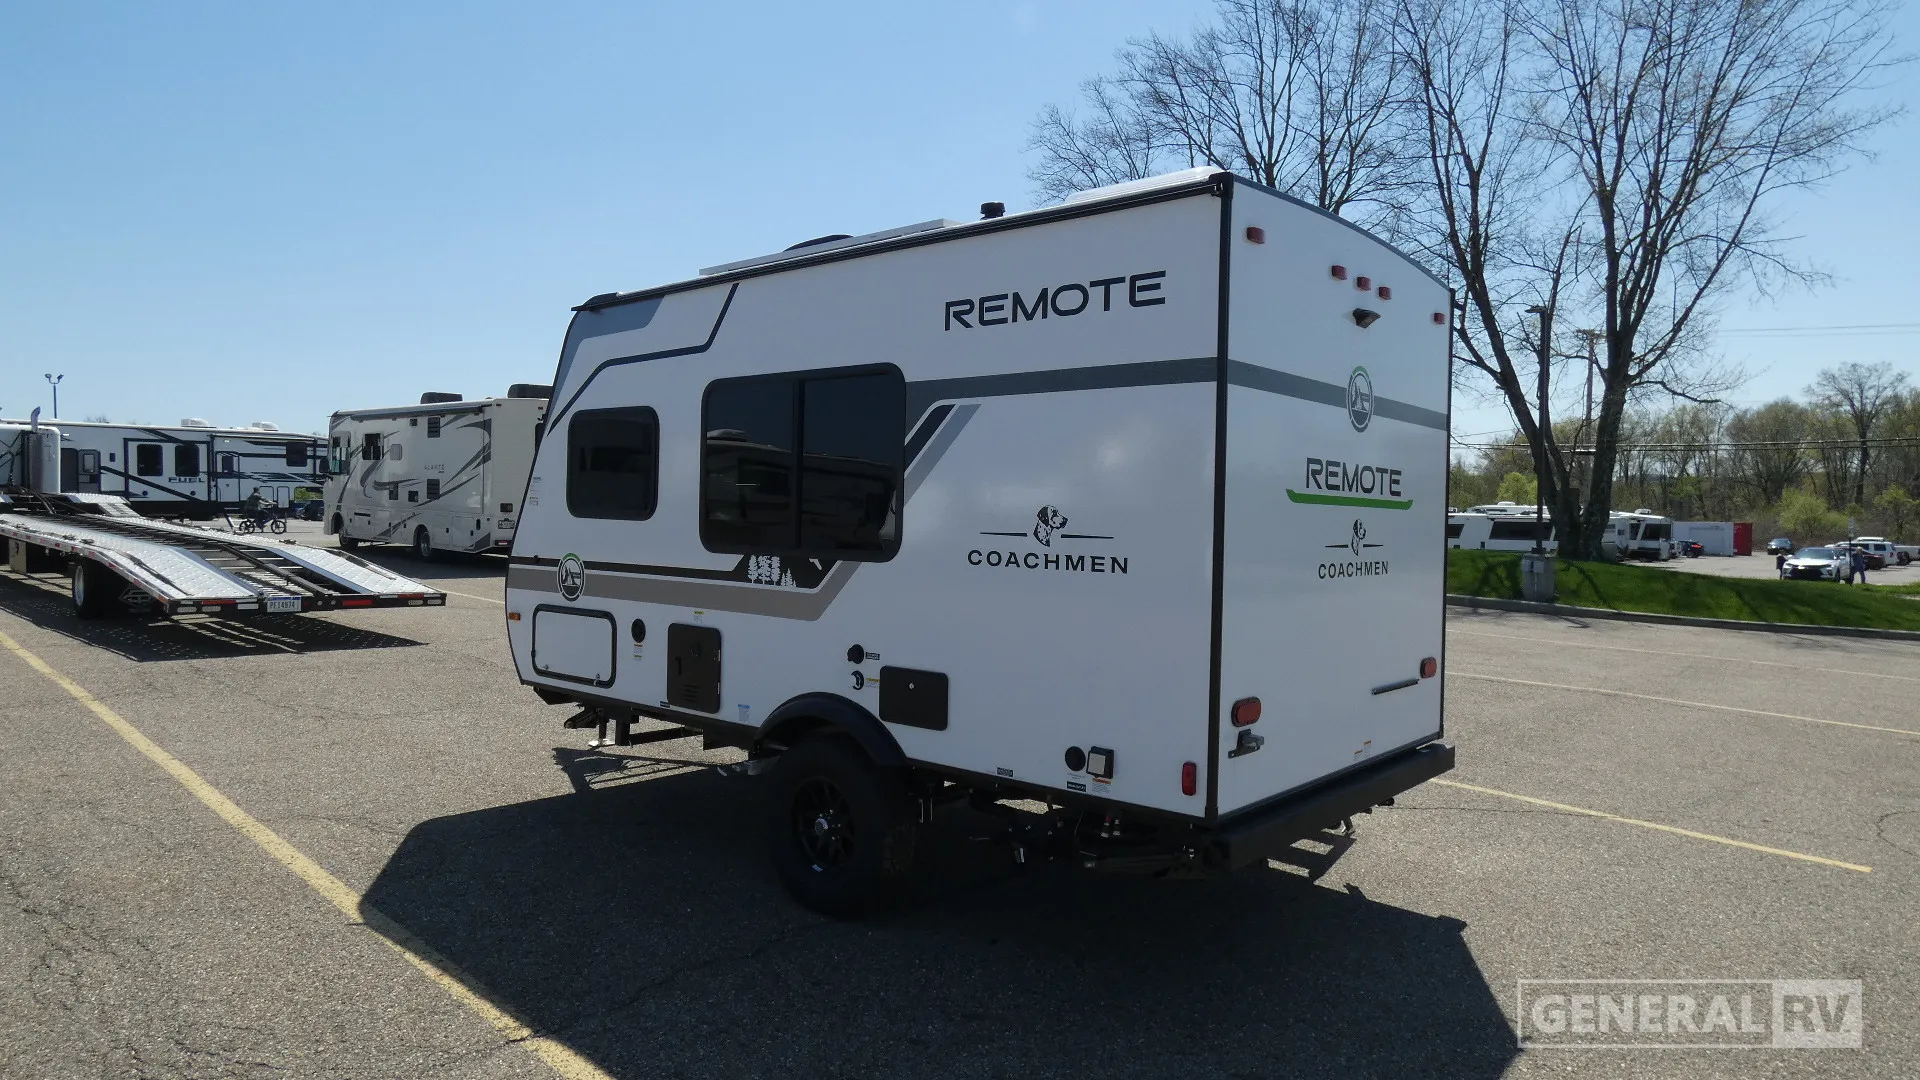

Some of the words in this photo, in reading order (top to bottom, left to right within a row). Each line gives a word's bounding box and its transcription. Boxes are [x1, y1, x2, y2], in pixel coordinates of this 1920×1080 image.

[944, 270, 1166, 331] REMOTE
[168, 476, 206, 484] FUEL
[1305, 457, 1402, 497] REMOTE
[967, 549, 1128, 574] COACHMEN
[1317, 560, 1389, 580] COACHMEN
